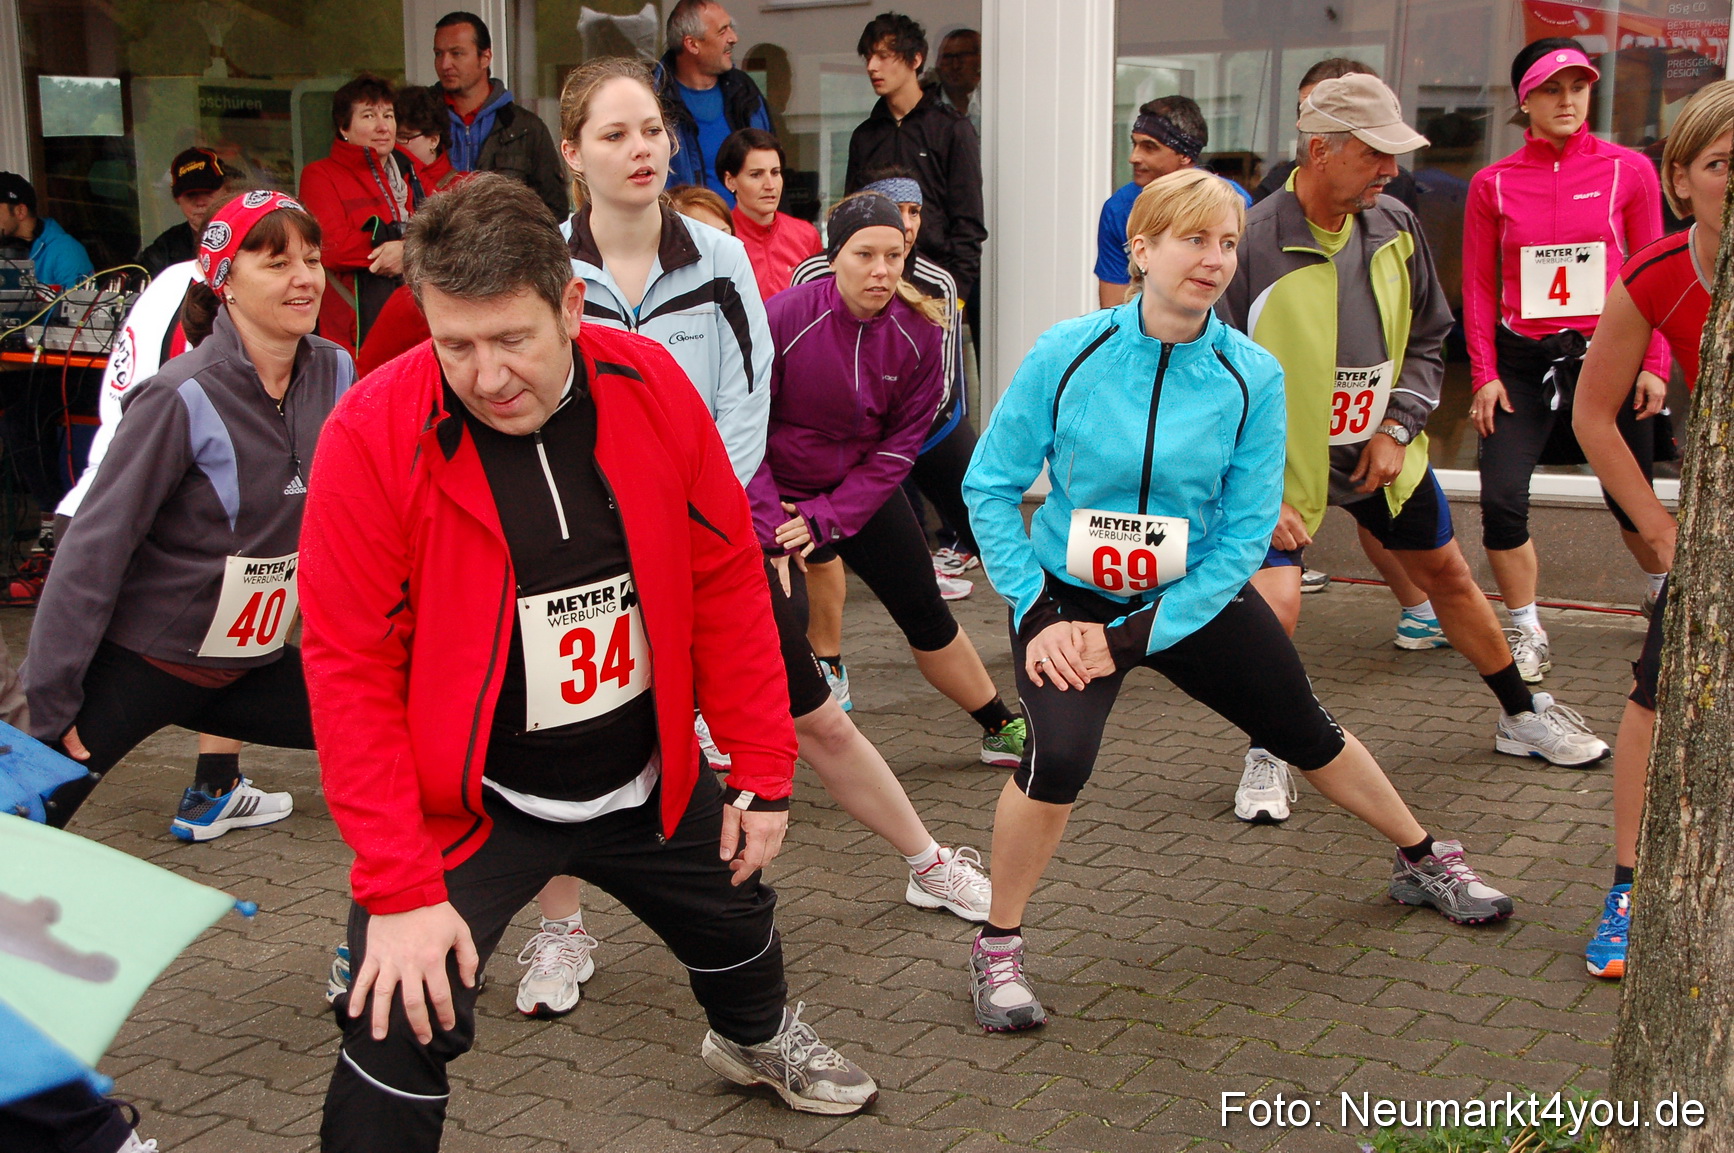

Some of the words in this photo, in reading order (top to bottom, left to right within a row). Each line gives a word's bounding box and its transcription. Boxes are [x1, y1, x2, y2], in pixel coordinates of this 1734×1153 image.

[1667, 19, 1701, 30] BESTER
[1666, 68, 1699, 78] DESIGN
[1534, 256, 1573, 265] WERBUNG
[1535, 248, 1573, 258] MEYER
[1548, 266, 1571, 306] 4
[1335, 371, 1368, 381] EYER
[1334, 380, 1366, 388] ERBUNG
[1329, 389, 1375, 437] 33
[284, 486, 307, 495] adidas
[1089, 515, 1142, 533] MEYER
[1088, 528, 1142, 543] WERBUNG
[244, 561, 285, 576] MEYER
[1092, 545, 1159, 591] 69
[243, 573, 284, 585] WERBUNG
[547, 585, 616, 617] MEYER
[226, 587, 287, 647] 40
[547, 601, 617, 628] WERBUNG
[559, 612, 636, 705] 34
